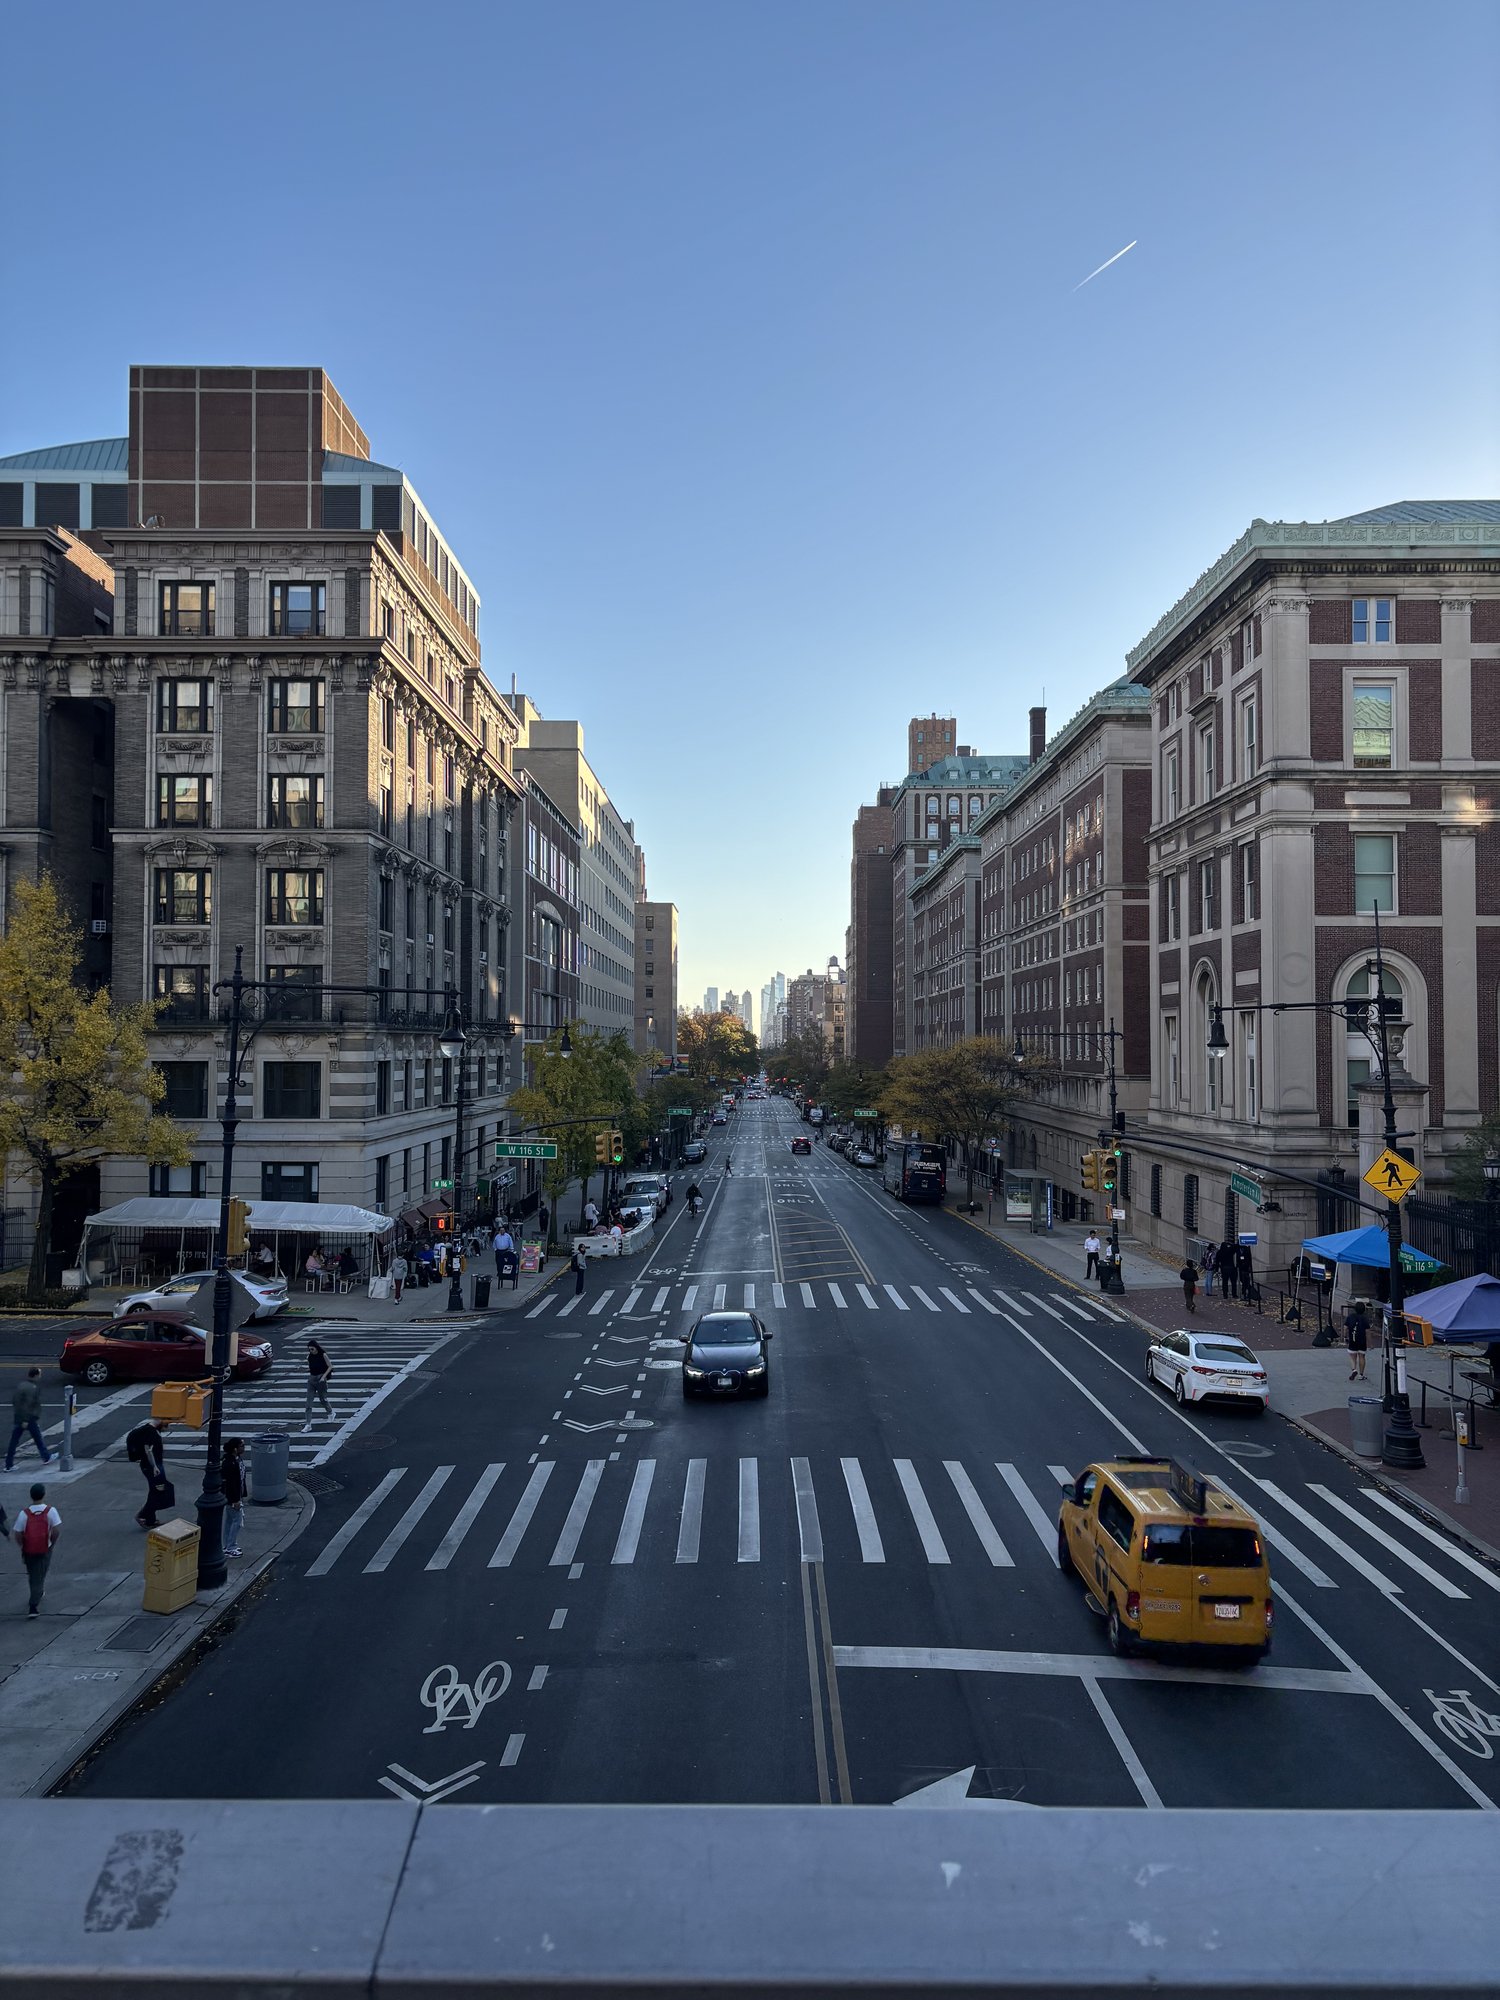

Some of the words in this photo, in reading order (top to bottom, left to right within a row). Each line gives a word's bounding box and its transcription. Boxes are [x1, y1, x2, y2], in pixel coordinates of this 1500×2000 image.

[508, 1146, 516, 1155] W
[519, 1146, 533, 1155] 116
[535, 1146, 545, 1156] St
[1415, 1261, 1426, 1272] 116
